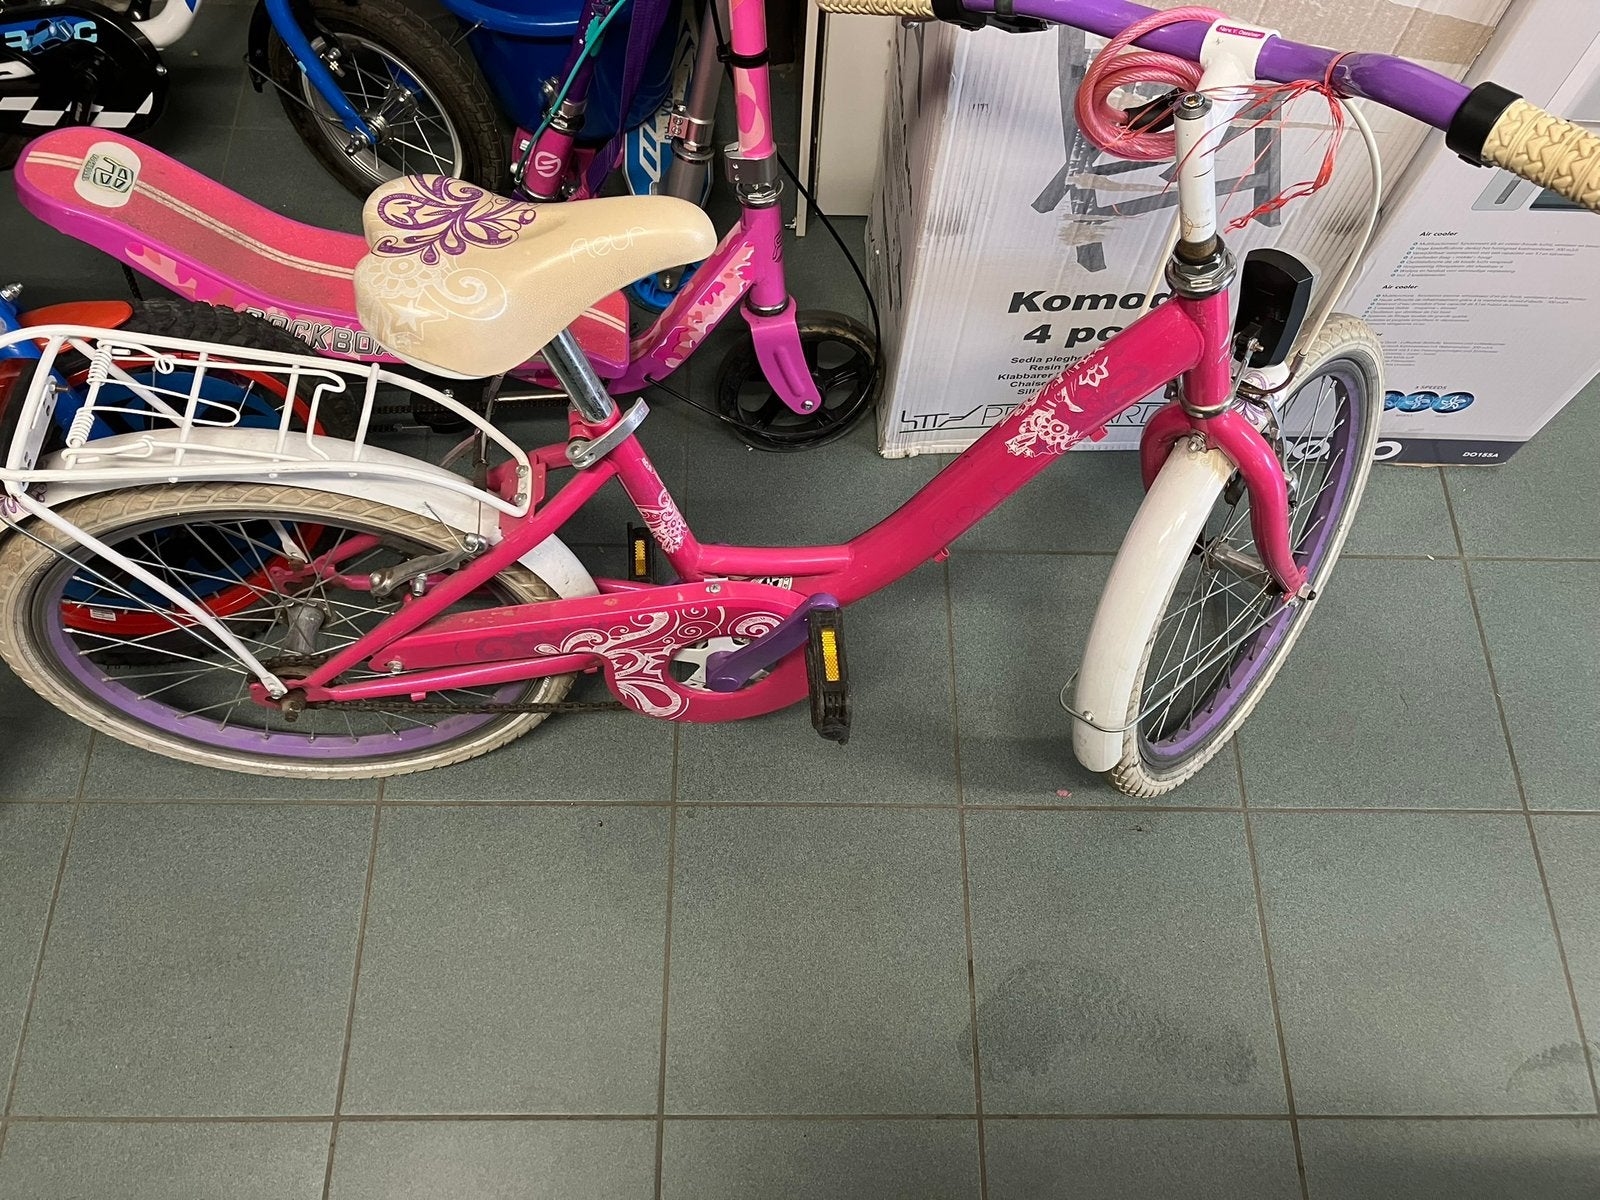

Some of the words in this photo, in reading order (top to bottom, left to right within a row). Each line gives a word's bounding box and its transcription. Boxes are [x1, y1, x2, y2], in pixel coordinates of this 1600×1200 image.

[1023, 323, 1052, 344] 4
[1010, 355, 1043, 364] Sedia
[1029, 363, 1061, 371] Resin
[998, 372, 1053, 380] Klabbarer
